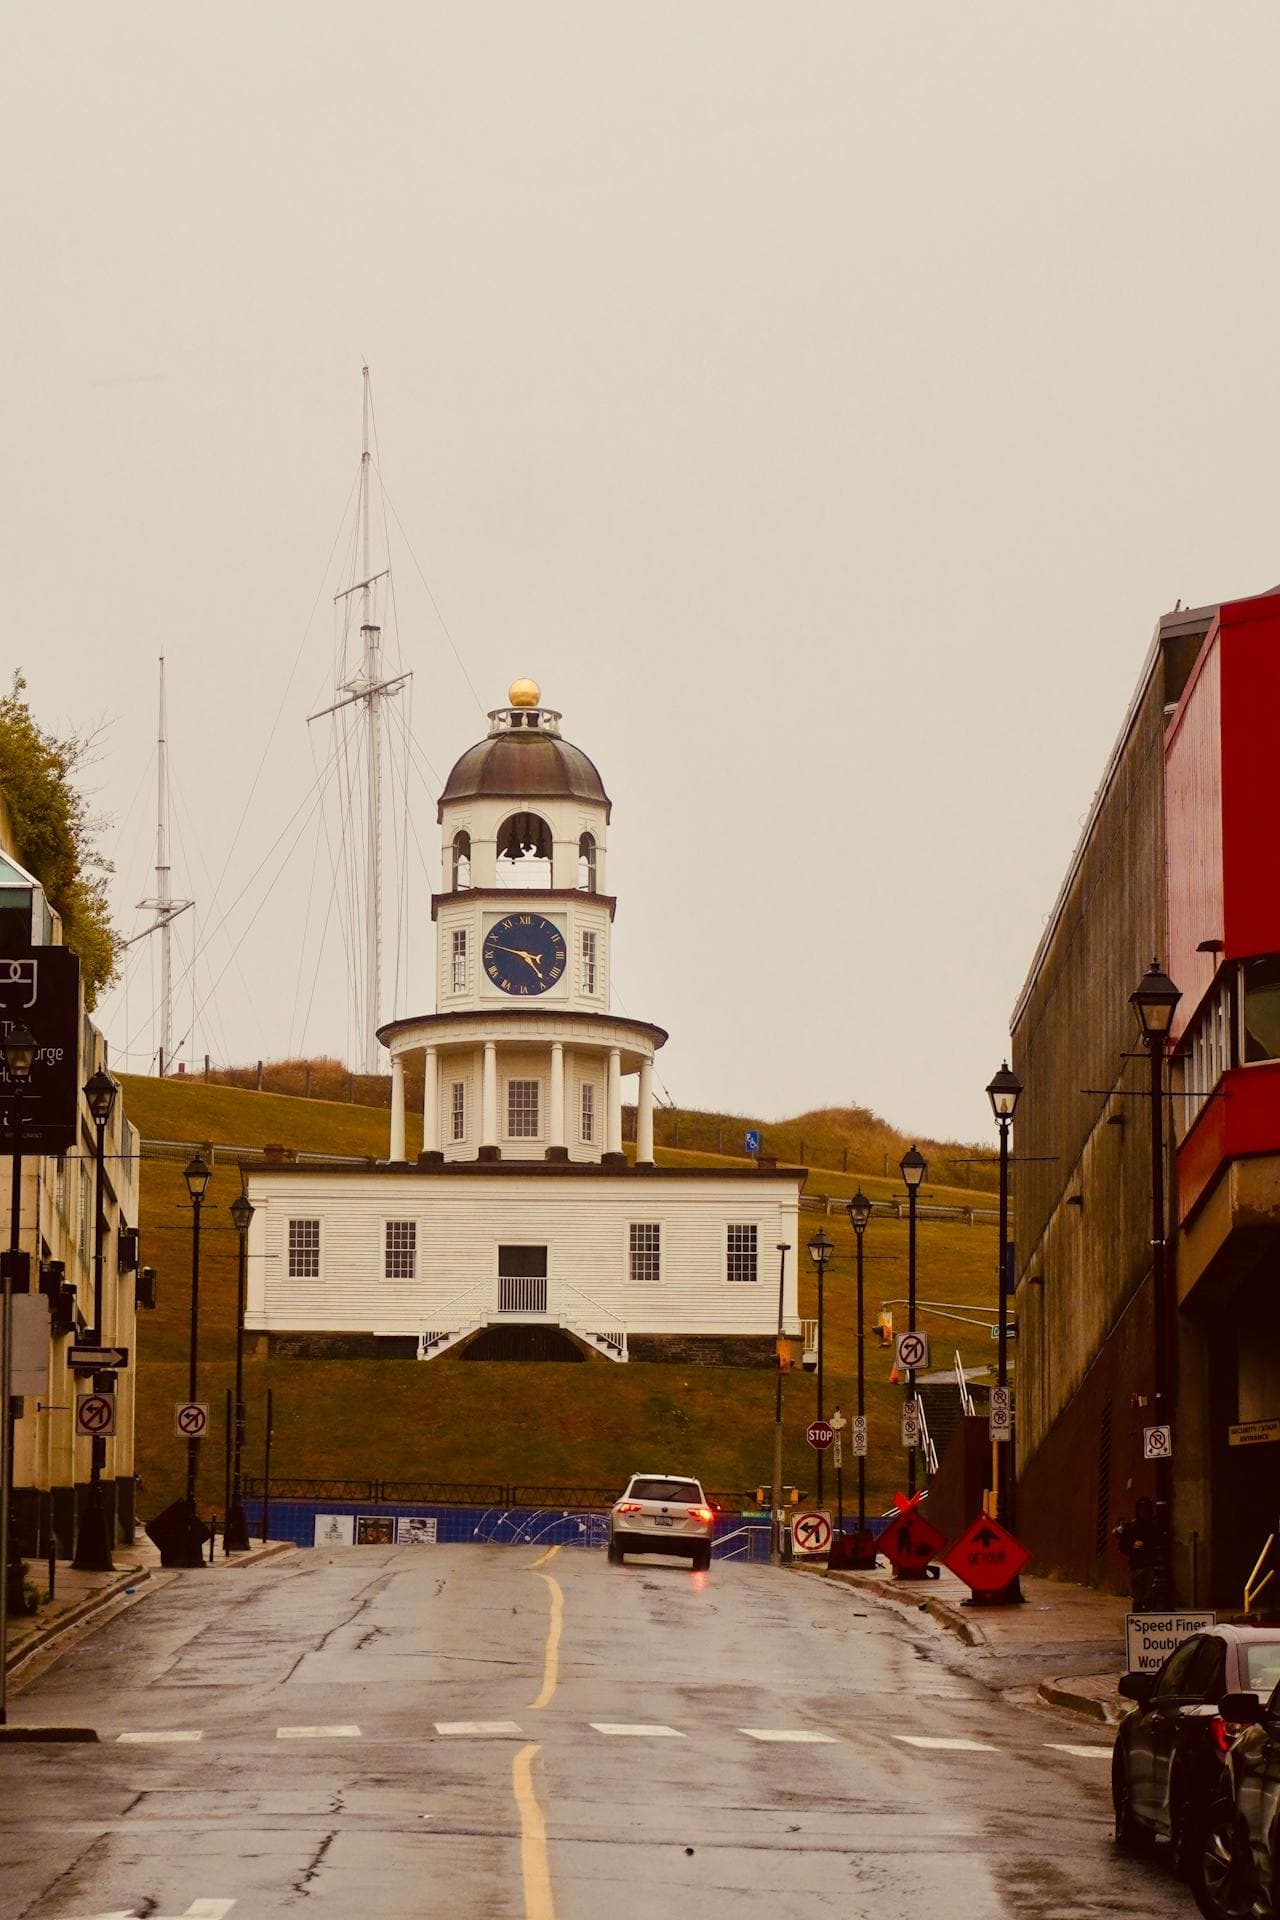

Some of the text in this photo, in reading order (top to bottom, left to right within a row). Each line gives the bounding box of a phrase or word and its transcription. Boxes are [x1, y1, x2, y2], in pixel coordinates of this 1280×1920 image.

[519, 916, 531, 925] XII
[808, 1430, 833, 1441] STOP
[968, 1551, 1007, 1564] DETOUR
[1134, 1619, 1207, 1634] Speed Fines
